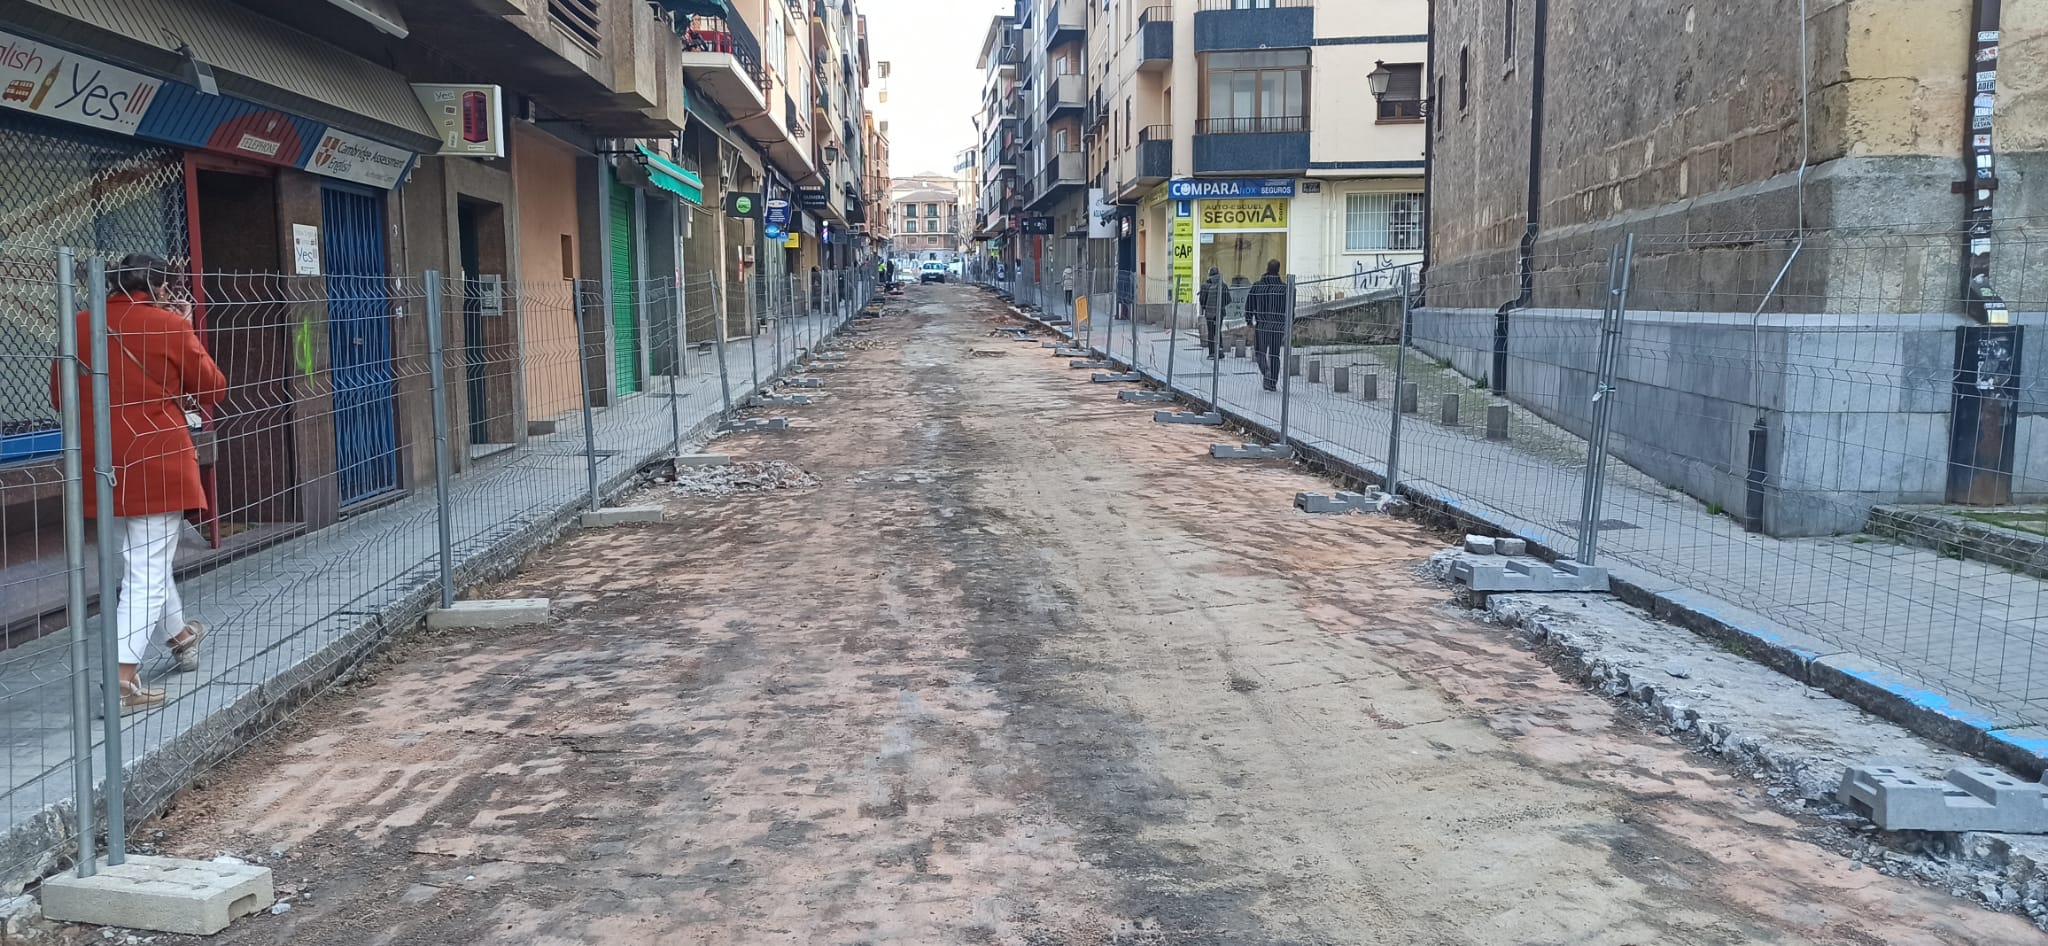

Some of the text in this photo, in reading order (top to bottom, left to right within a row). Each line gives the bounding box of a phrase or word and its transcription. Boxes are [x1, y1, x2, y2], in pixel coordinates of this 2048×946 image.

[241, 137, 278, 154] TELEPHONE
[337, 141, 406, 169] Cambridge Assessment
[328, 157, 351, 174] English
[1261, 186, 1291, 194] SEGUROS
[1178, 201, 1189, 216] L
[1204, 203, 1277, 224] SEGOVIA
[1174, 244, 1193, 258] CAP
